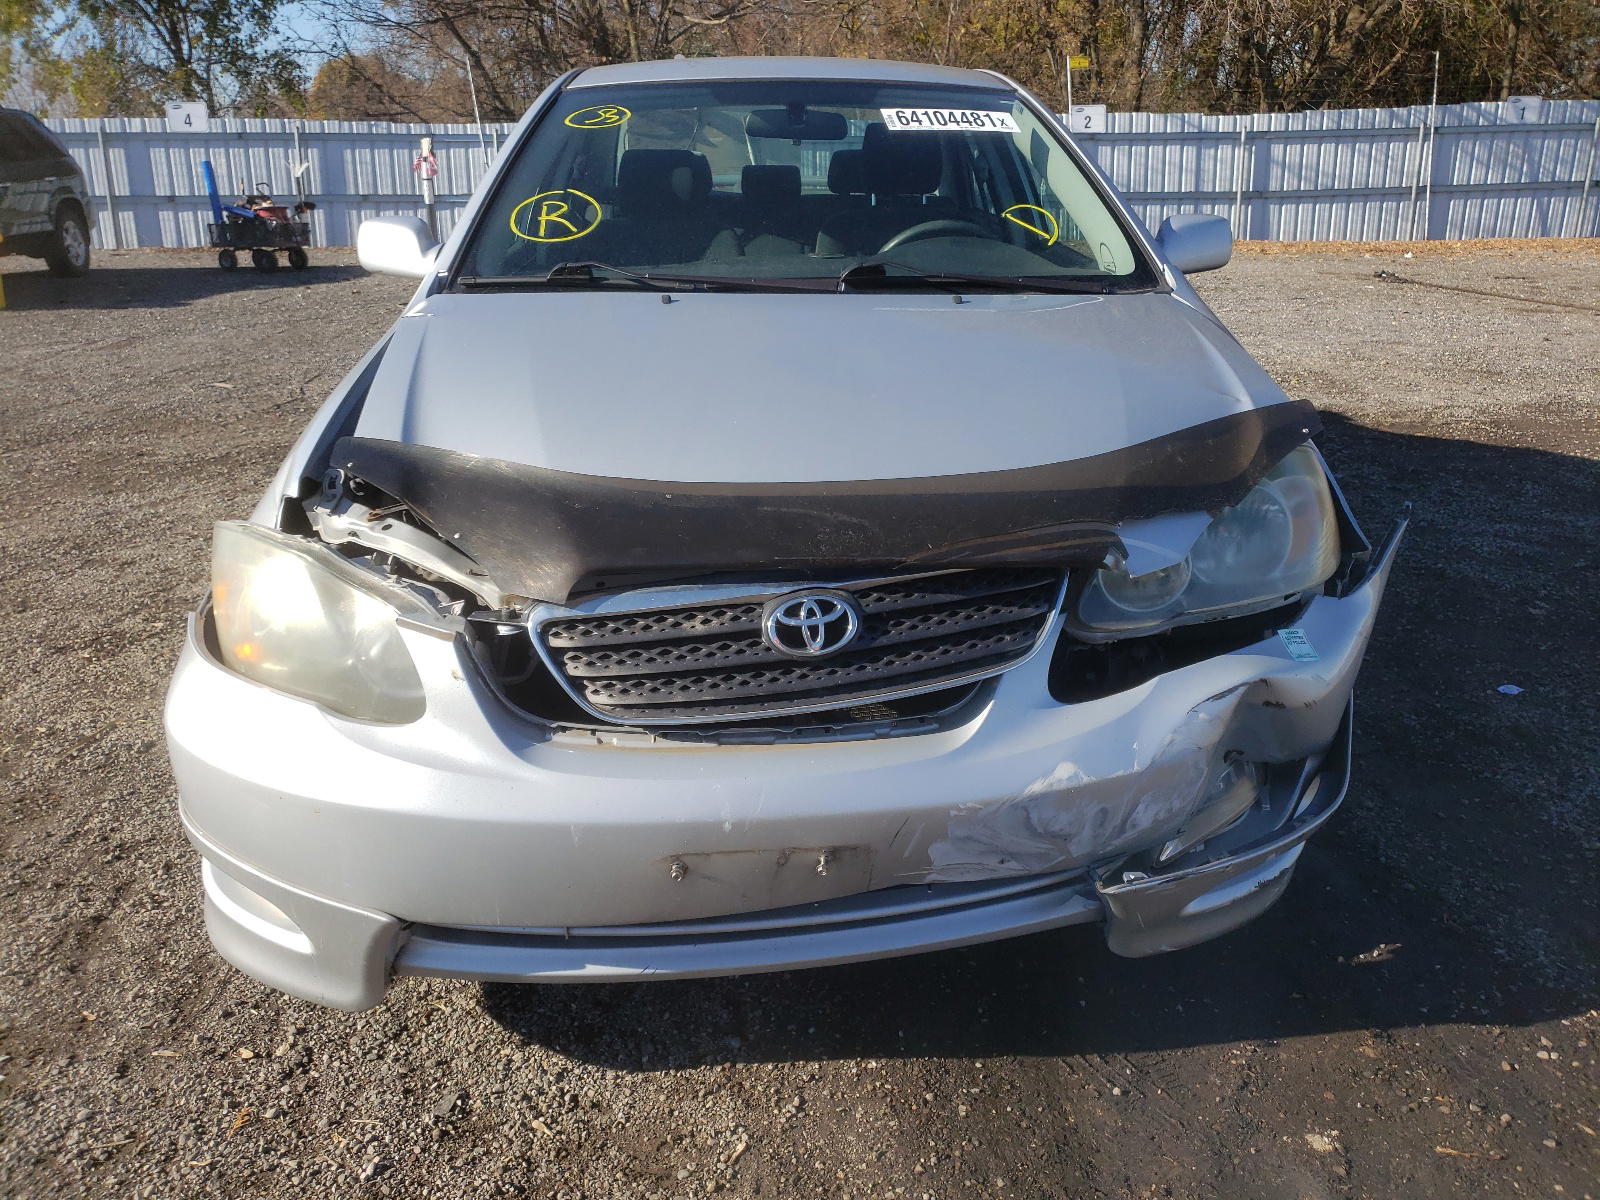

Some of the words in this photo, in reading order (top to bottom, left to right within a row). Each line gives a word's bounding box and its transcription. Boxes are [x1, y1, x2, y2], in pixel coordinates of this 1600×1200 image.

[184, 113, 193, 128] 4
[895, 110, 998, 128] 64104481
[1519, 106, 1526, 120] 1
[1084, 115, 1092, 129] 2
[537, 201, 578, 237] R
